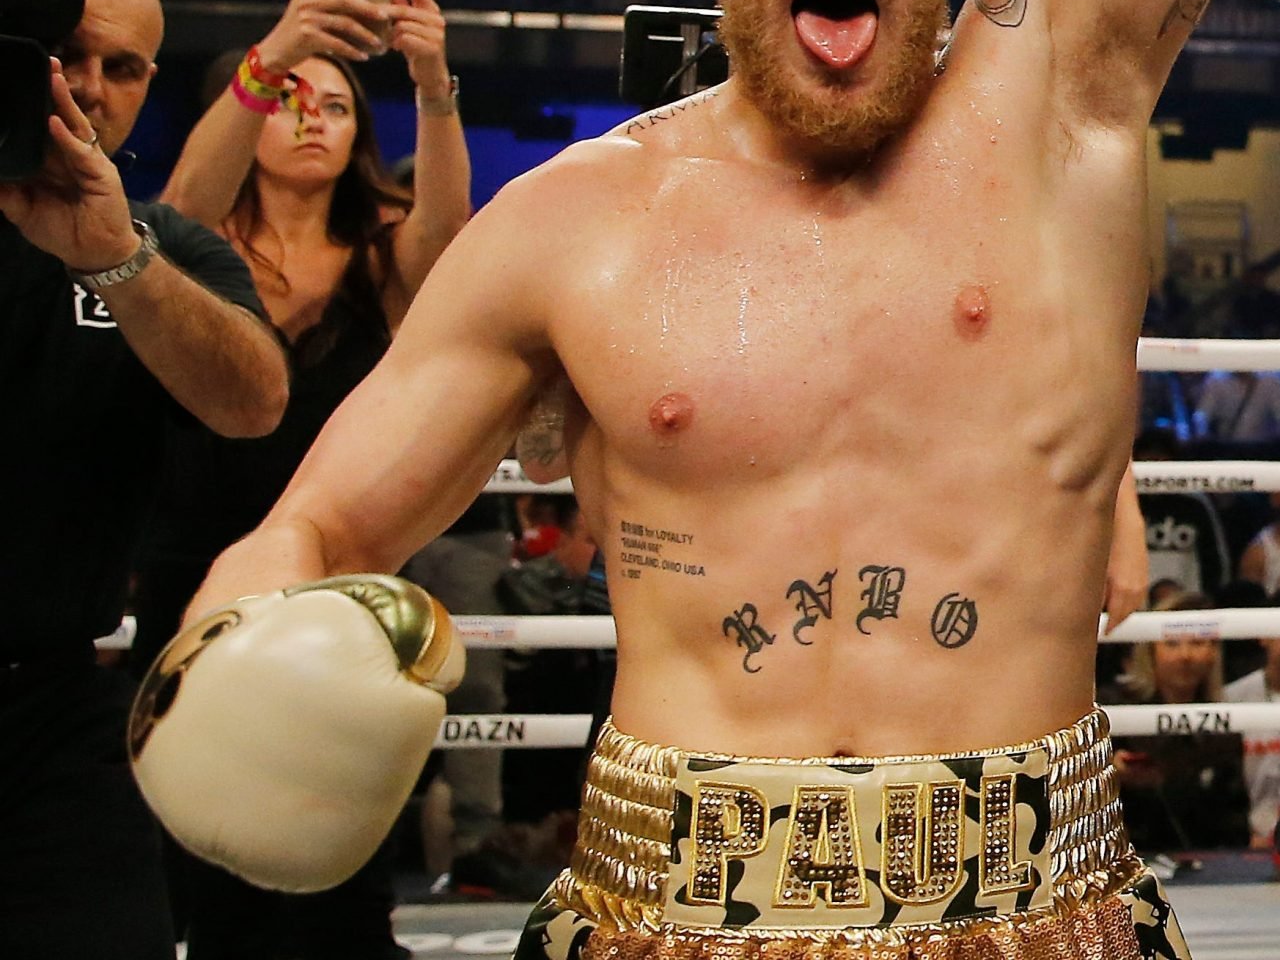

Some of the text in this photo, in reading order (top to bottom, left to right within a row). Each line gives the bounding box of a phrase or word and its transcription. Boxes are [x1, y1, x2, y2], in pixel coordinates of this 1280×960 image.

[656, 529, 694, 545] LOYALTY
[661, 559, 682, 573] OHIO
[683, 563, 706, 577] USA
[444, 721, 525, 741] DAZN
[1157, 713, 1231, 735] DAZN
[686, 772, 1036, 910] PAUL
